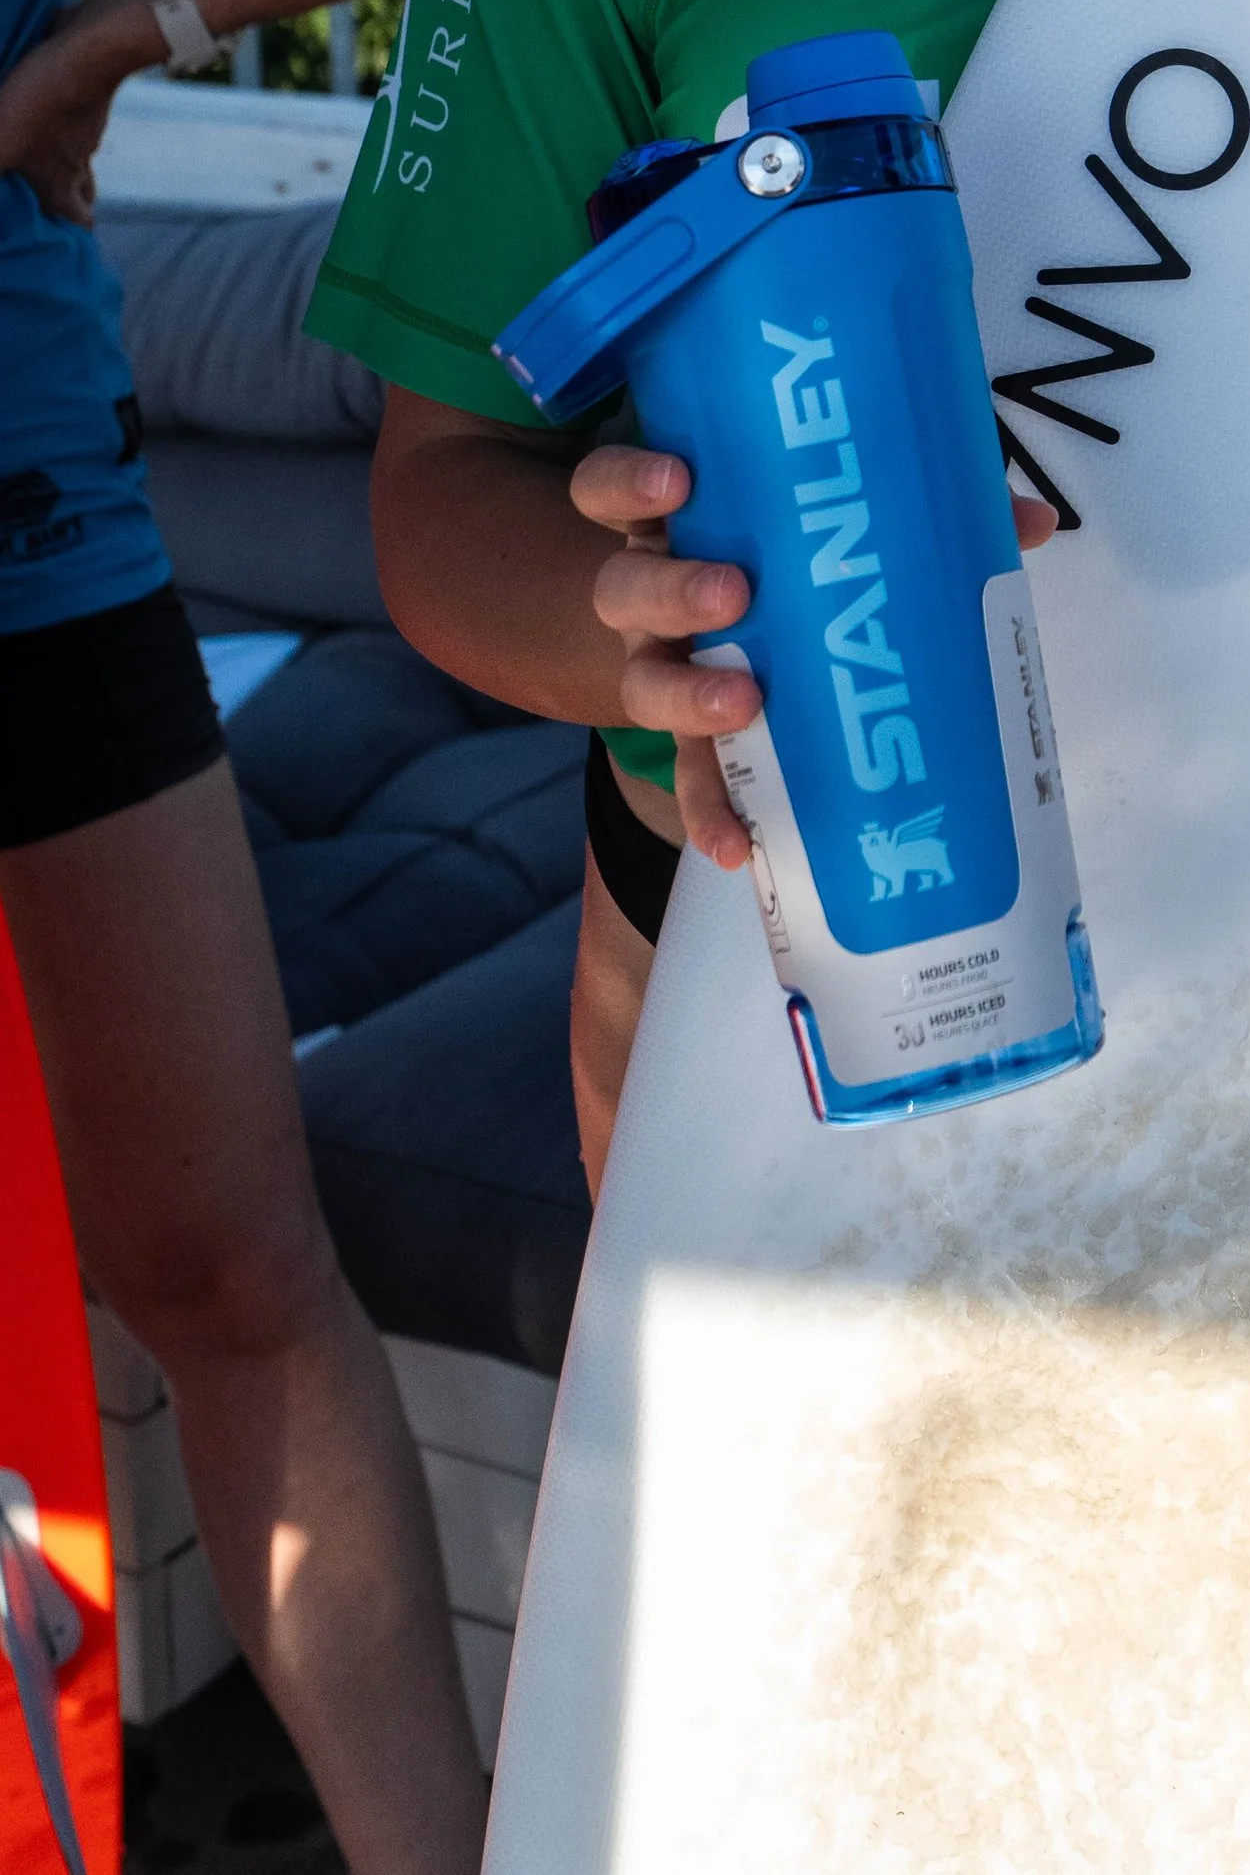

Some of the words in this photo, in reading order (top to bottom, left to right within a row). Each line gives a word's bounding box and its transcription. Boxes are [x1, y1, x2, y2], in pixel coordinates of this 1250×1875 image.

[760, 319, 928, 795] STANLEY
[919, 959, 966, 982] HOURS
[967, 948, 1000, 968] COLD
[929, 1004, 977, 1027] HOURS
[977, 993, 1006, 1014] ICED
